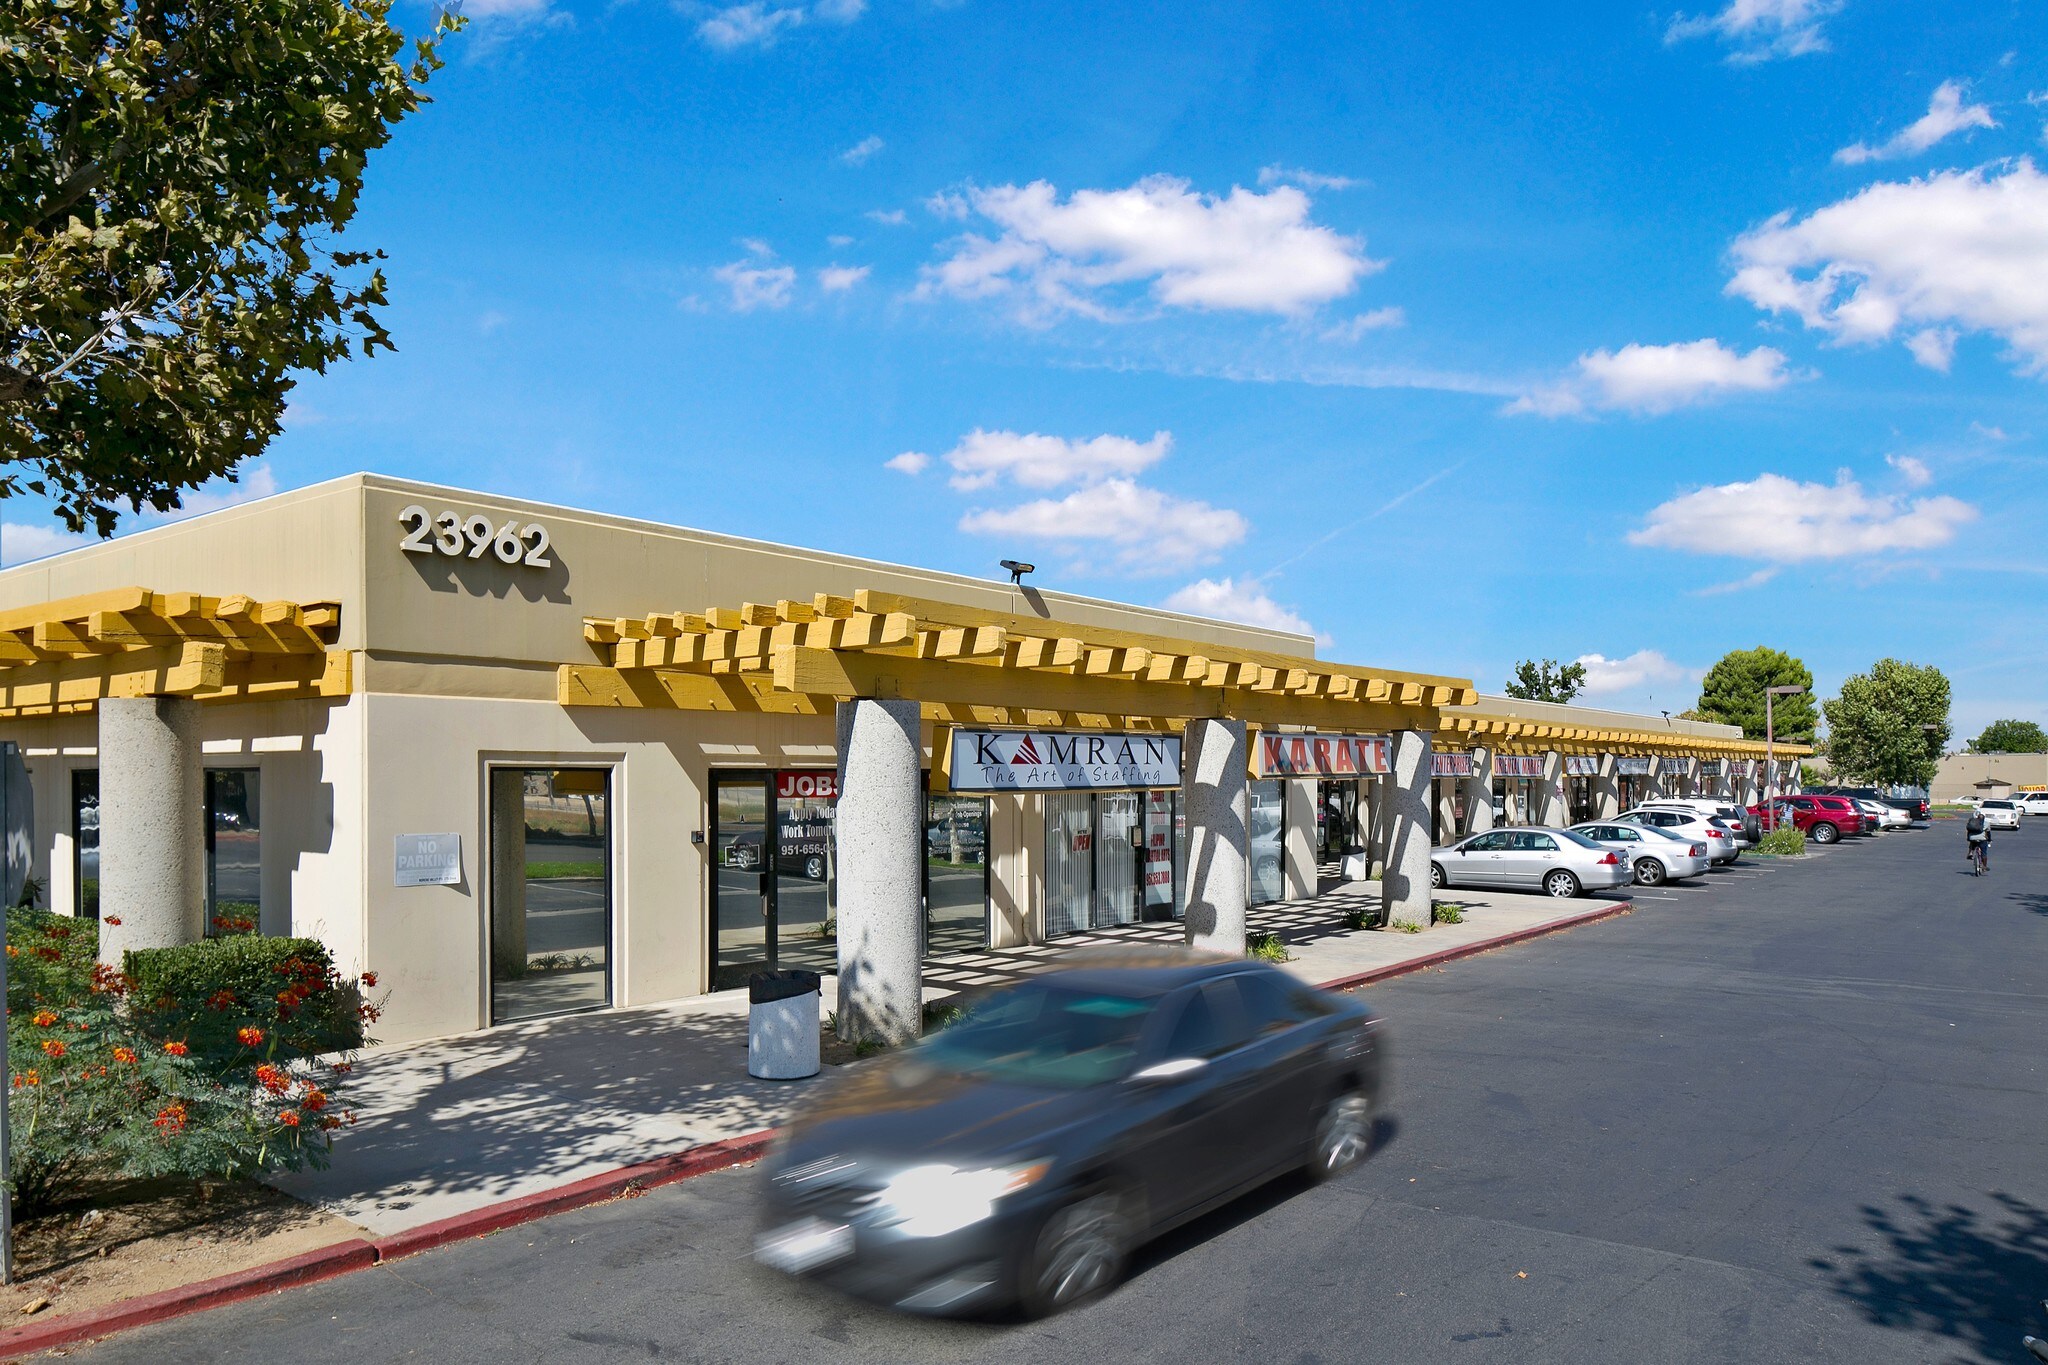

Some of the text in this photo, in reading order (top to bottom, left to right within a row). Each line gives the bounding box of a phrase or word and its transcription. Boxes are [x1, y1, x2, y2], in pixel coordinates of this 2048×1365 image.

[397, 504, 552, 569] 23962
[975, 734, 1166, 765] KAMRAN
[1263, 736, 1388, 773] KARATE
[1435, 754, 1472, 774] ENTERPRISES
[1494, 756, 1543, 775] ORIENTAL MARKET
[980, 766, 1162, 785] The Art of Staffing
[779, 775, 838, 797] JOB
[788, 807, 813, 822] Apply
[781, 825, 804, 839] Work
[417, 840, 437, 854] NO
[1072, 834, 1091, 852] OPEN
[398, 853, 456, 869] PARKING
